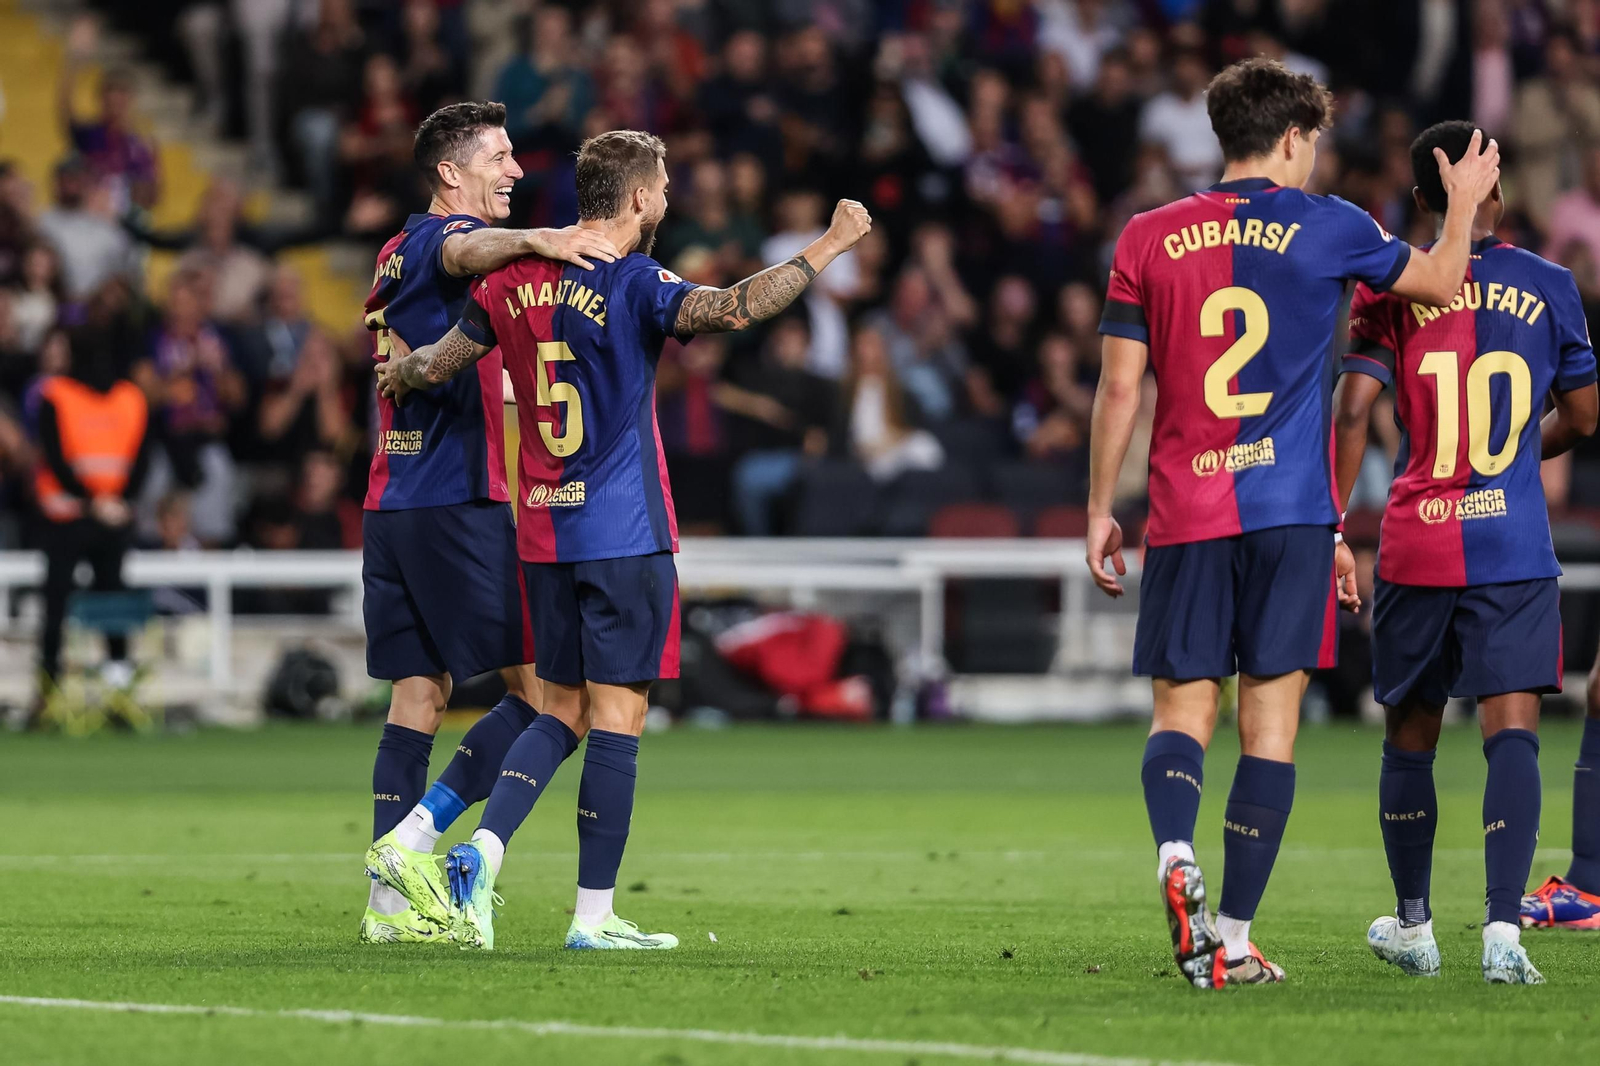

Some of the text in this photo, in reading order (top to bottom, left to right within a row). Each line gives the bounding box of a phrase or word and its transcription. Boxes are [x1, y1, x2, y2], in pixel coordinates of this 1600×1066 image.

[1163, 218, 1301, 260] CUBARSÍ
[1486, 282, 1546, 326] FATI
[1200, 286, 1274, 419] 2
[537, 341, 584, 457] 5
[1417, 351, 1532, 479] 10
[384, 440, 423, 451] ACNUR
[385, 430, 423, 441] UNHCR
[1226, 437, 1274, 457] UNHCR
[1224, 448, 1275, 467] ACNUR
[1454, 499, 1507, 516] ACNUR
